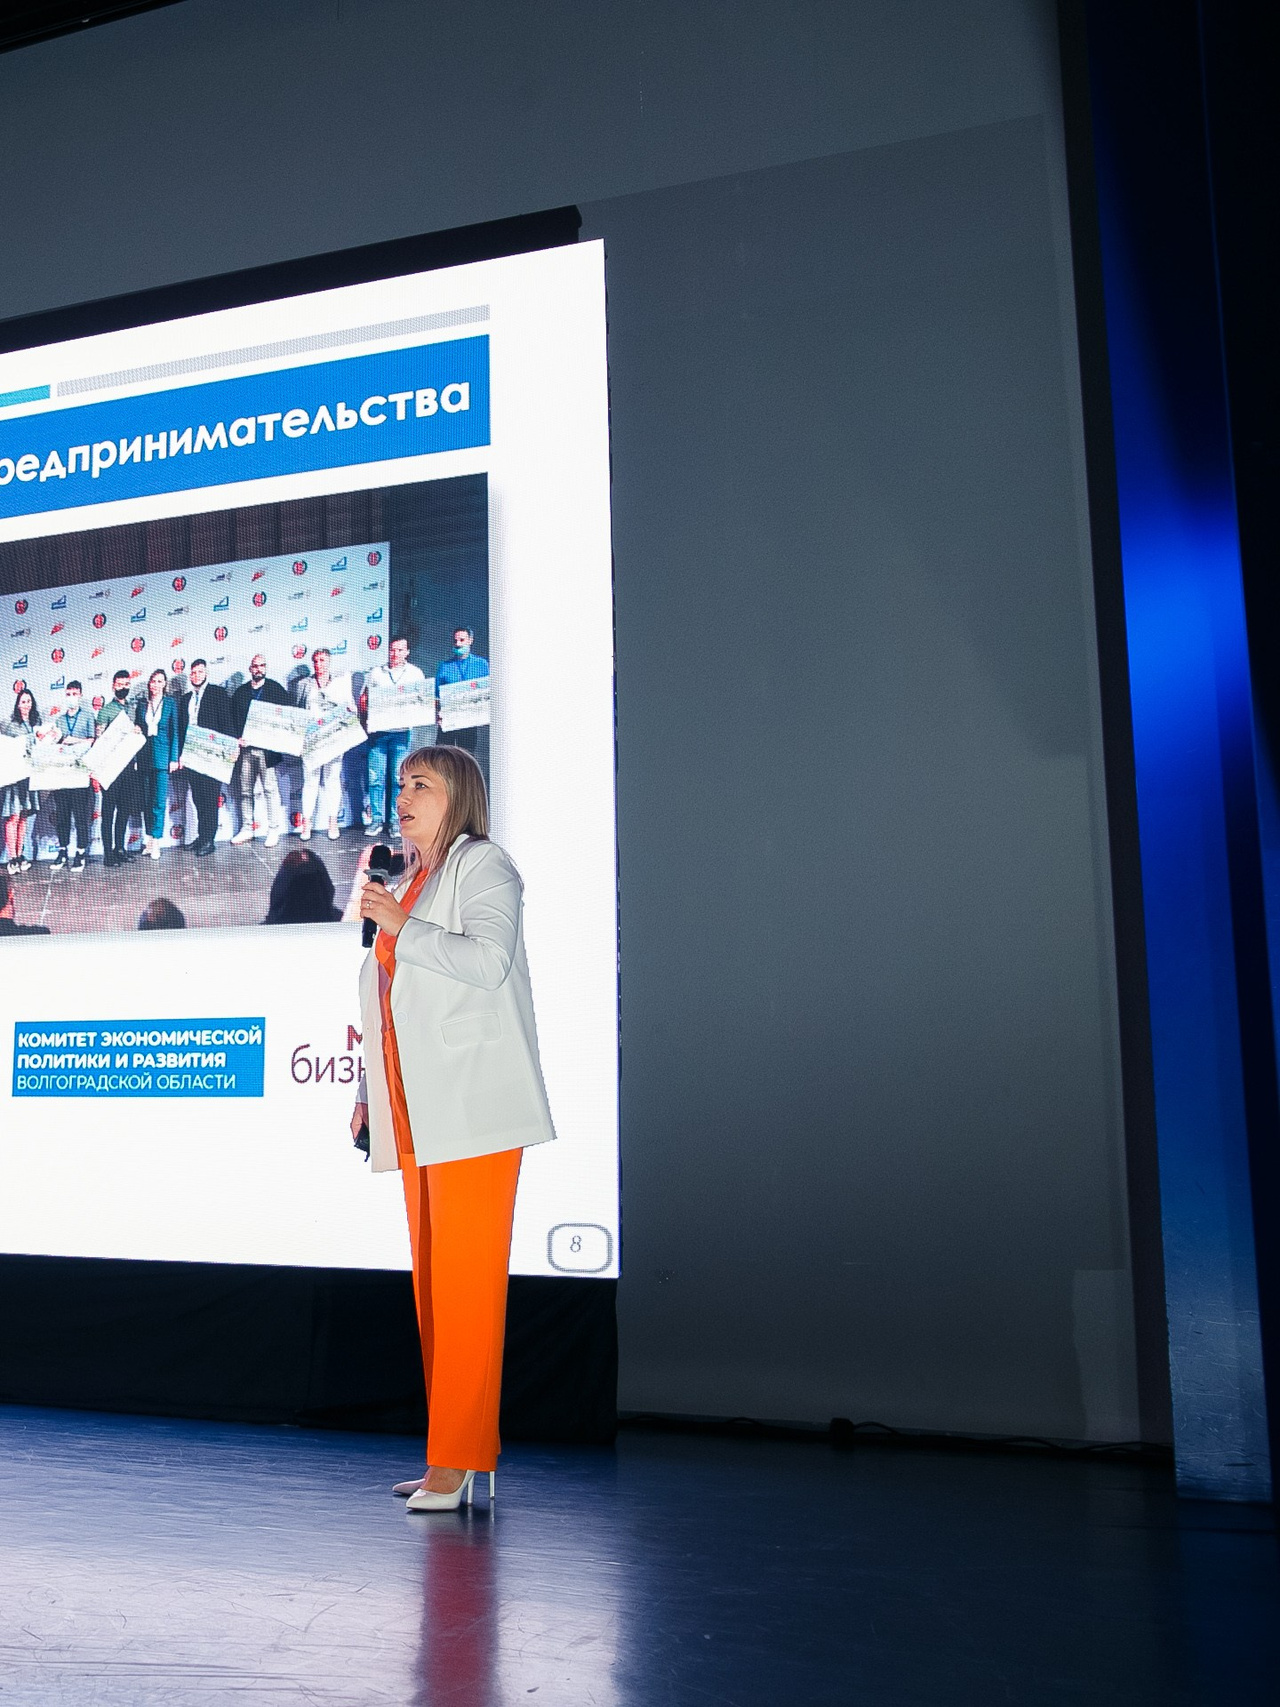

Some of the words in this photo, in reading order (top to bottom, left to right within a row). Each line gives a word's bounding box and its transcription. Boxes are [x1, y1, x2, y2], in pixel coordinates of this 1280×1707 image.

[17, 1031, 98, 1048] КОМИТЕТ
[100, 1024, 263, 1047] ЭКОНОМИЧЕСКОЙ
[17, 1053, 111, 1069] ПОЛИТИКИ
[115, 1053, 129, 1069] И
[132, 1052, 227, 1069] РАЗВИТИЯ
[17, 1071, 152, 1092] ВОЛГОГРАДСКОЙ
[156, 1073, 236, 1090] ОБЛАСТИ
[569, 1235, 582, 1253] 8
